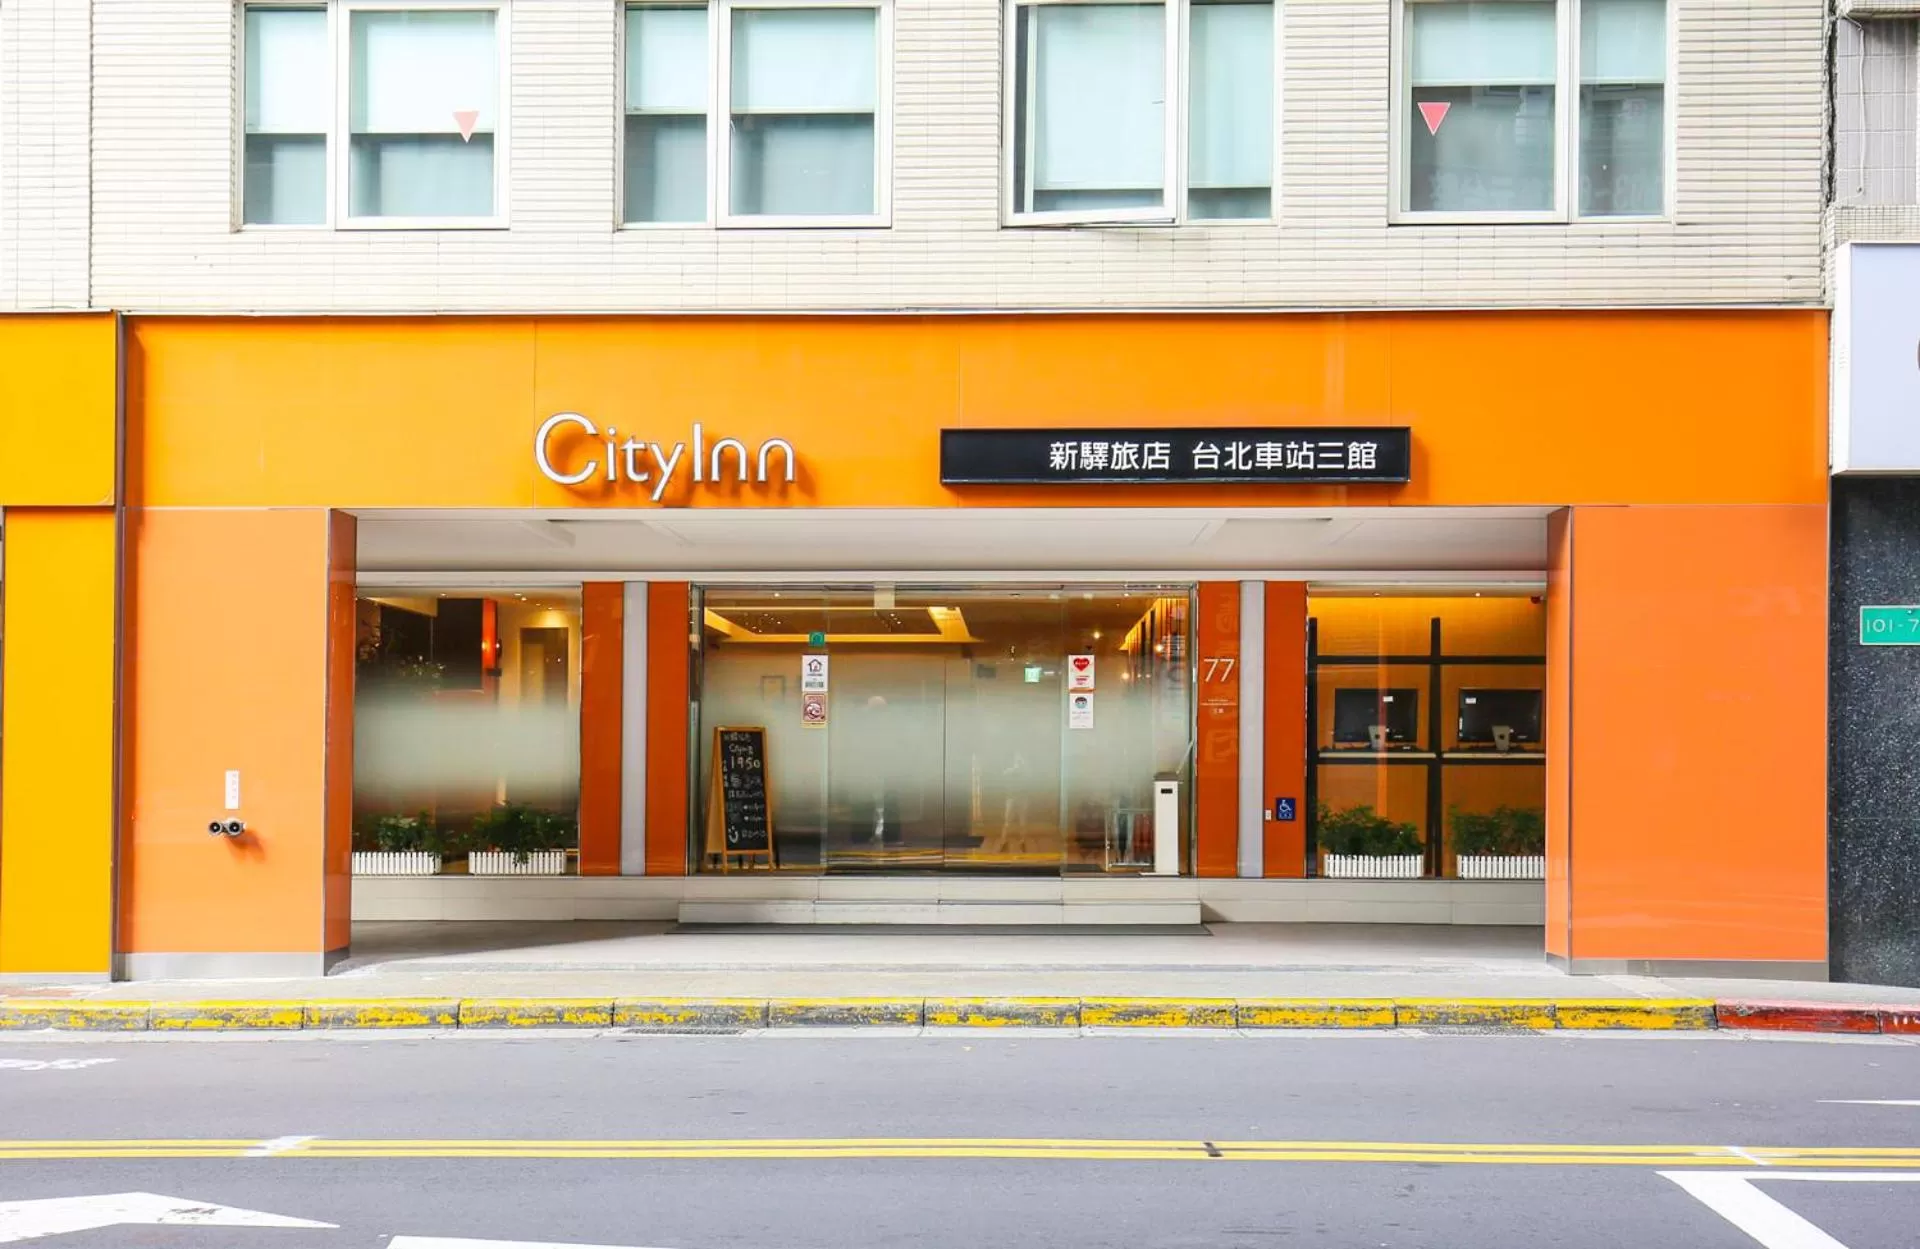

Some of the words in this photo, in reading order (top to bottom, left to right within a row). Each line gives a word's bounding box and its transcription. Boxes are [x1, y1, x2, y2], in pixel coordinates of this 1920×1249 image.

[1049, 441, 1171, 470] 新驛旅店
[1192, 441, 1378, 470] 台北車站三館
[1203, 658, 1236, 682] 77
